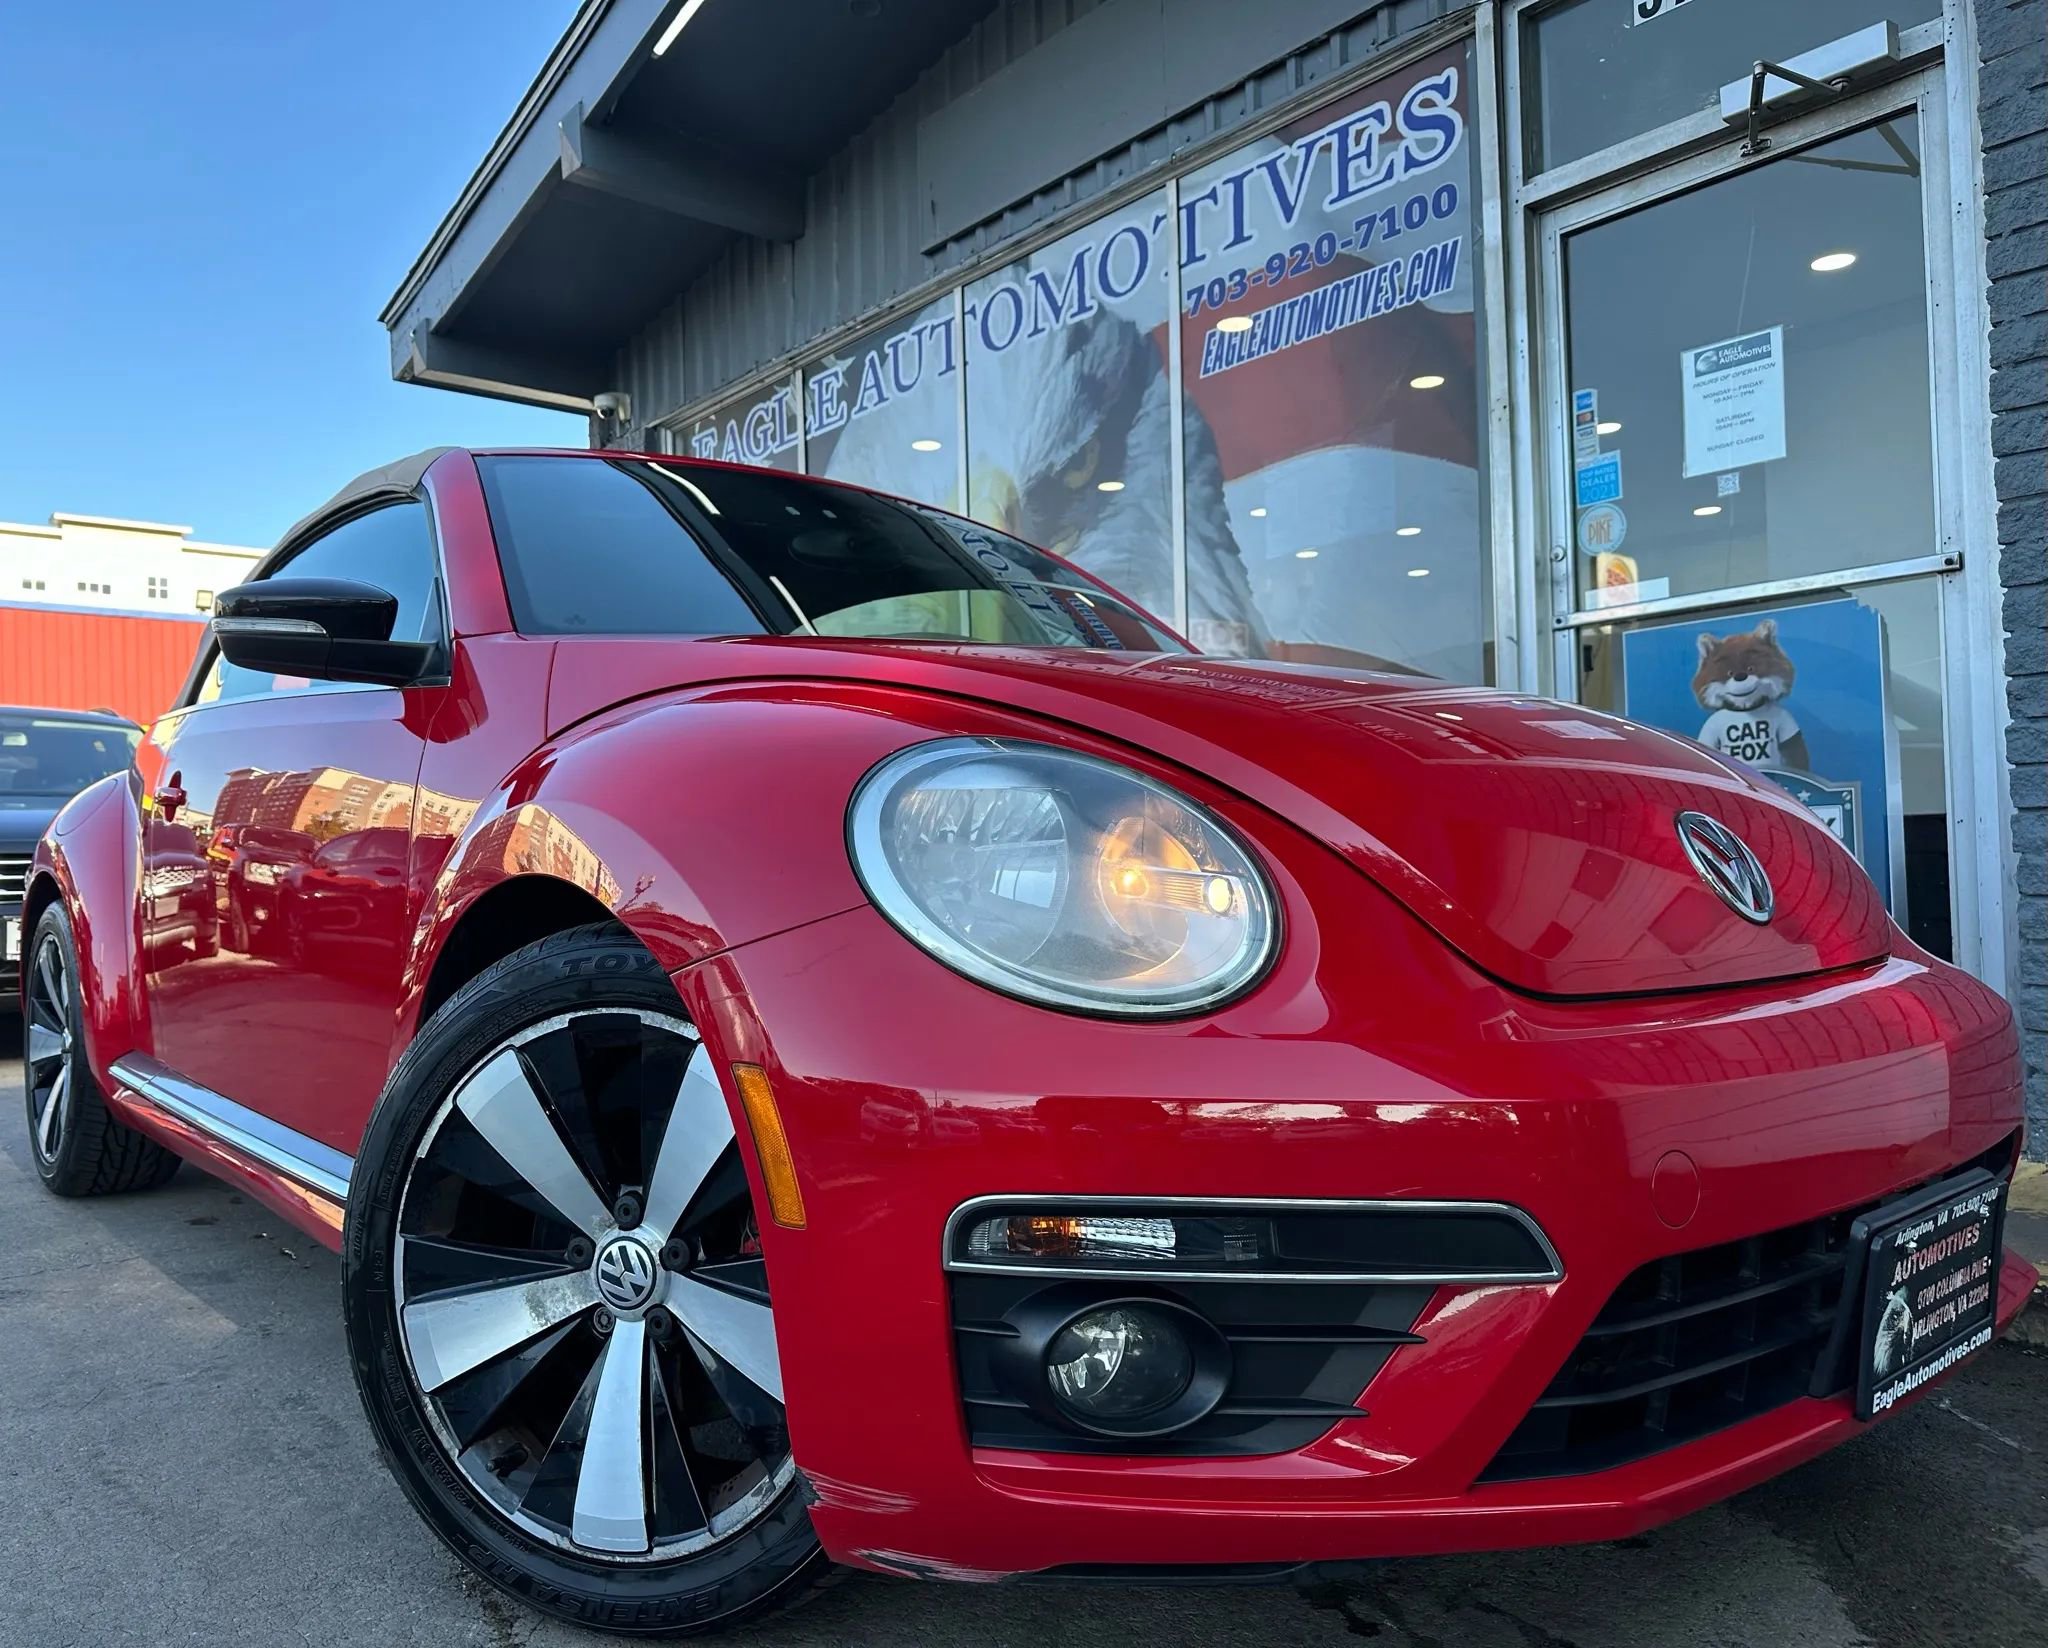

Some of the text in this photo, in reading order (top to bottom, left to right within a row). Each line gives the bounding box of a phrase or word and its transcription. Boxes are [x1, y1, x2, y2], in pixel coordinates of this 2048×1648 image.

[1187, 183, 1458, 318] 703-920-7100
[692, 68, 1462, 463] EAGLE AUTOMOTIVES
[1199, 236, 1462, 379] EAGLEAUTOMOTIVES.COM
[1719, 345, 1743, 358] EAGLE
[1719, 344, 1772, 365] AUTOMOTIVES
[1693, 362, 1776, 389] HOURS OF OPERATION
[1702, 387, 1731, 400] MONDAY
[1736, 434, 1764, 446] CLOSED
[1581, 473, 1616, 488] DEALER
[1581, 483, 1616, 503] 2021
[1726, 719, 1770, 743] CAR
[1730, 740, 1771, 762] FOX
[560, 951, 667, 978] TOY
[1937, 1211, 1949, 1227] VA
[1890, 1221, 1980, 1287] AUTOMOTIVES
[1958, 1293, 1967, 1315] VA
[1871, 1325, 1993, 1415] EagleAutomotives.com
